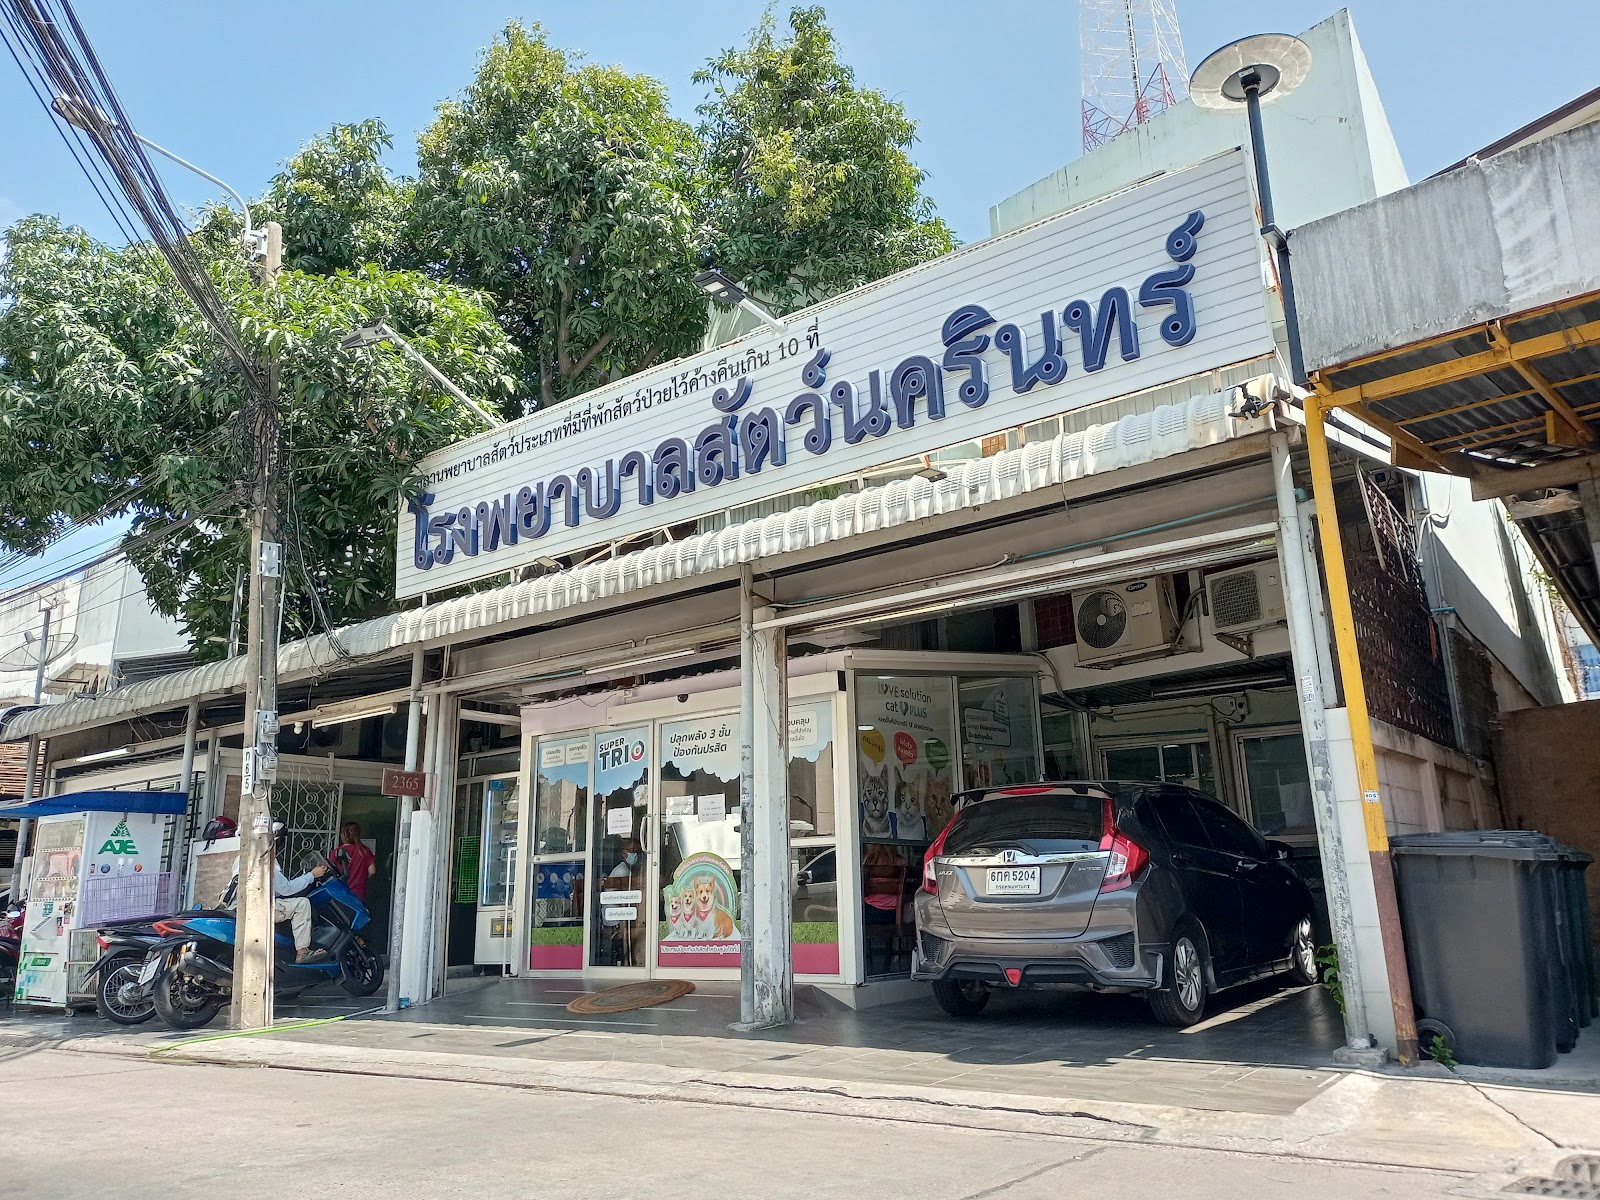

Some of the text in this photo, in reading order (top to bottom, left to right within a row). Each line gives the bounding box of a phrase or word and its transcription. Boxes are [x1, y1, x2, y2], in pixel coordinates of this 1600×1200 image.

[779, 337, 799, 361] 10
[806, 317, 820, 349] ที่
[407, 208, 1206, 571] โรงพยาบาลสัตว์นครินทร์
[900, 688, 932, 704] solution
[885, 701, 928, 719] cat PLUS
[670, 723, 732, 746] ปลุกพลัง 3 ชั้น
[599, 737, 625, 753] SUPER
[673, 742, 728, 758] ป้องกันปรสิต
[600, 740, 645, 771] TRIO
[392, 775, 419, 790] 2365
[97, 839, 139, 855] AJE
[990, 869, 1036, 882] 6กค 5204
